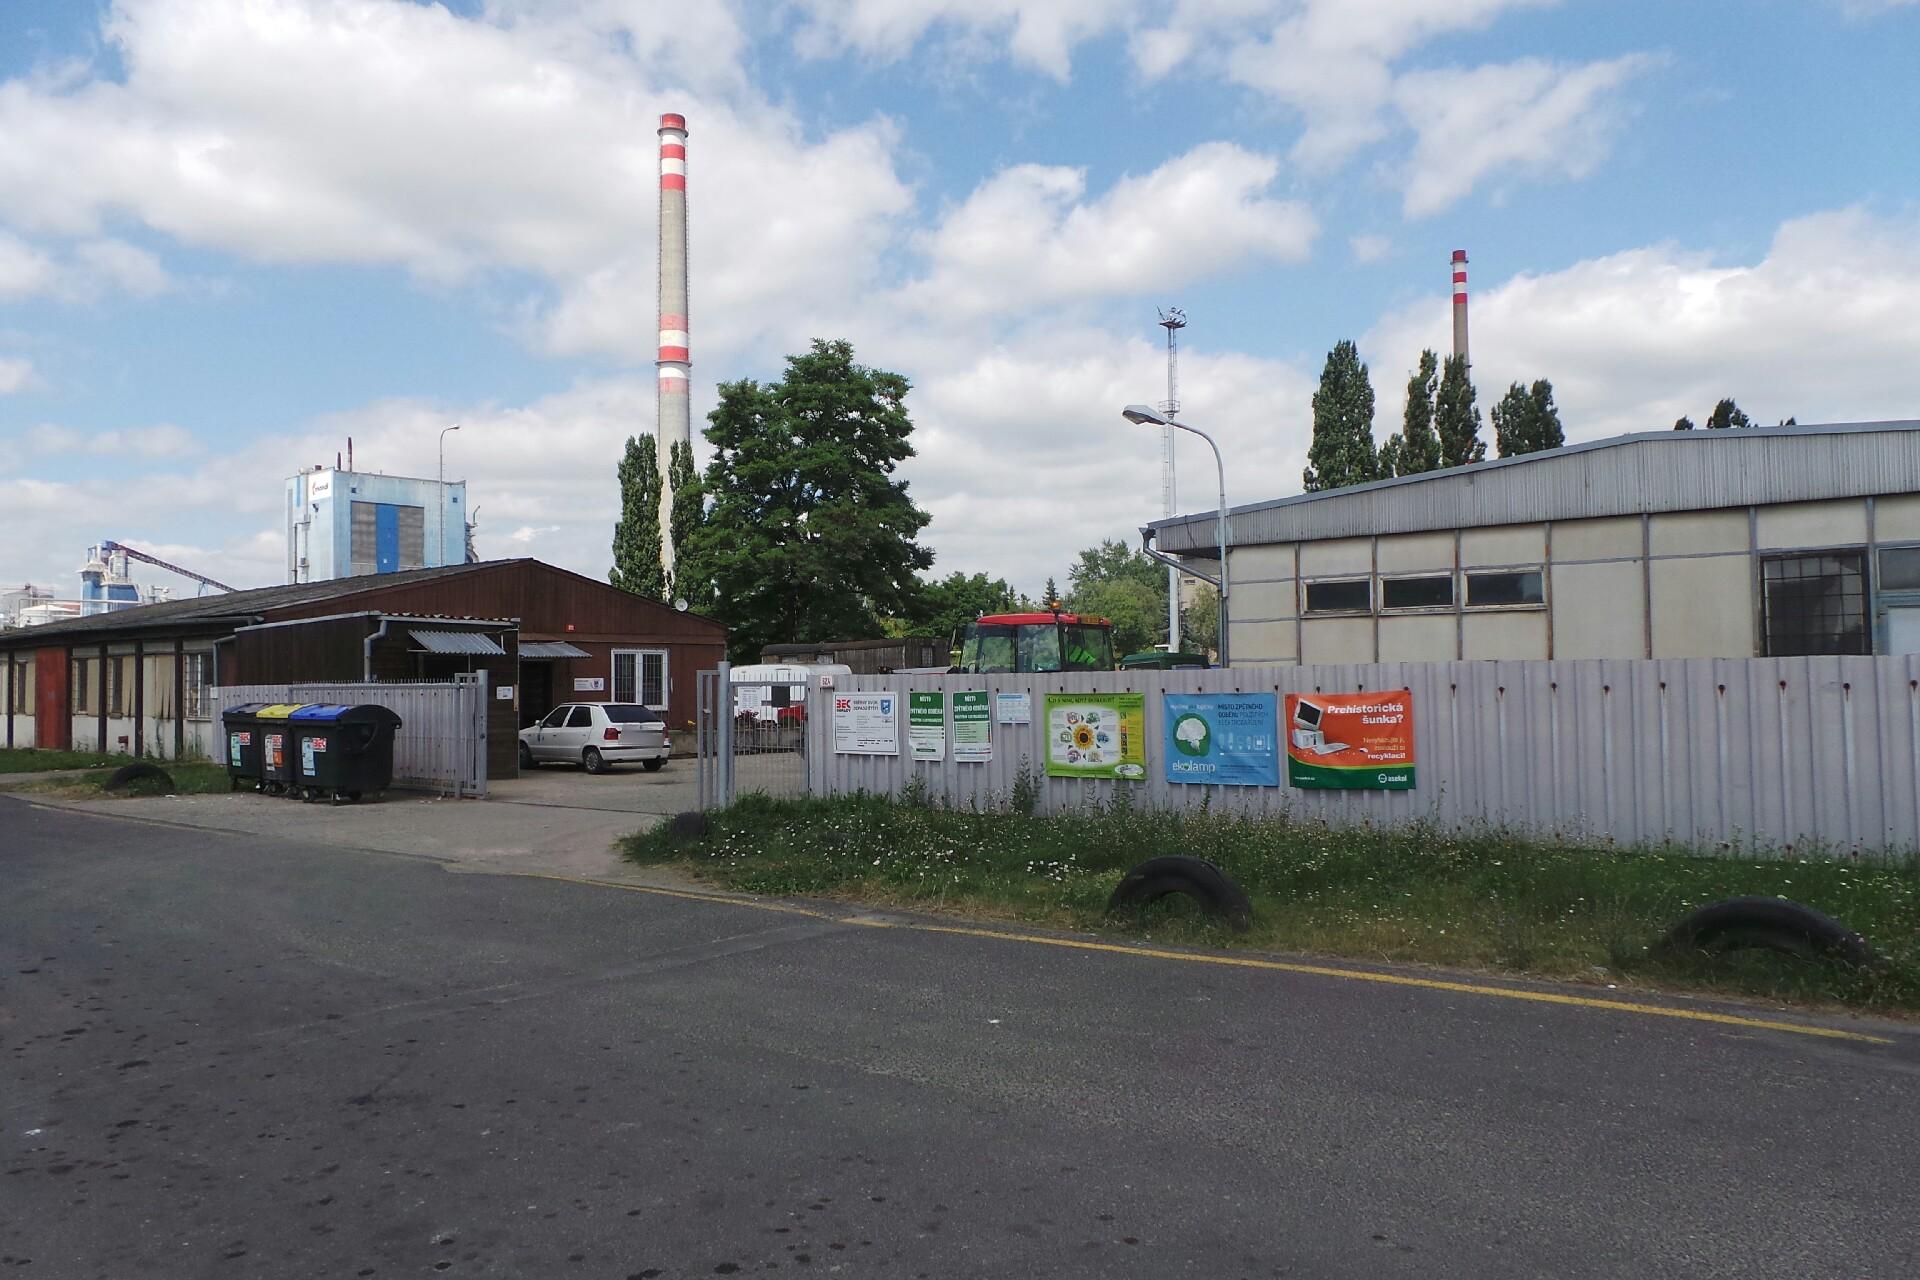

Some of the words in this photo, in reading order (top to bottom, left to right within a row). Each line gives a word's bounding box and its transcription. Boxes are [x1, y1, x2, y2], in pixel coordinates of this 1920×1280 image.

[836, 699, 851, 709] BEC
[1328, 703, 1403, 714] Prehistorická
[1362, 714, 1403, 724] šunka?
[1172, 760, 1216, 773] ekolamp
